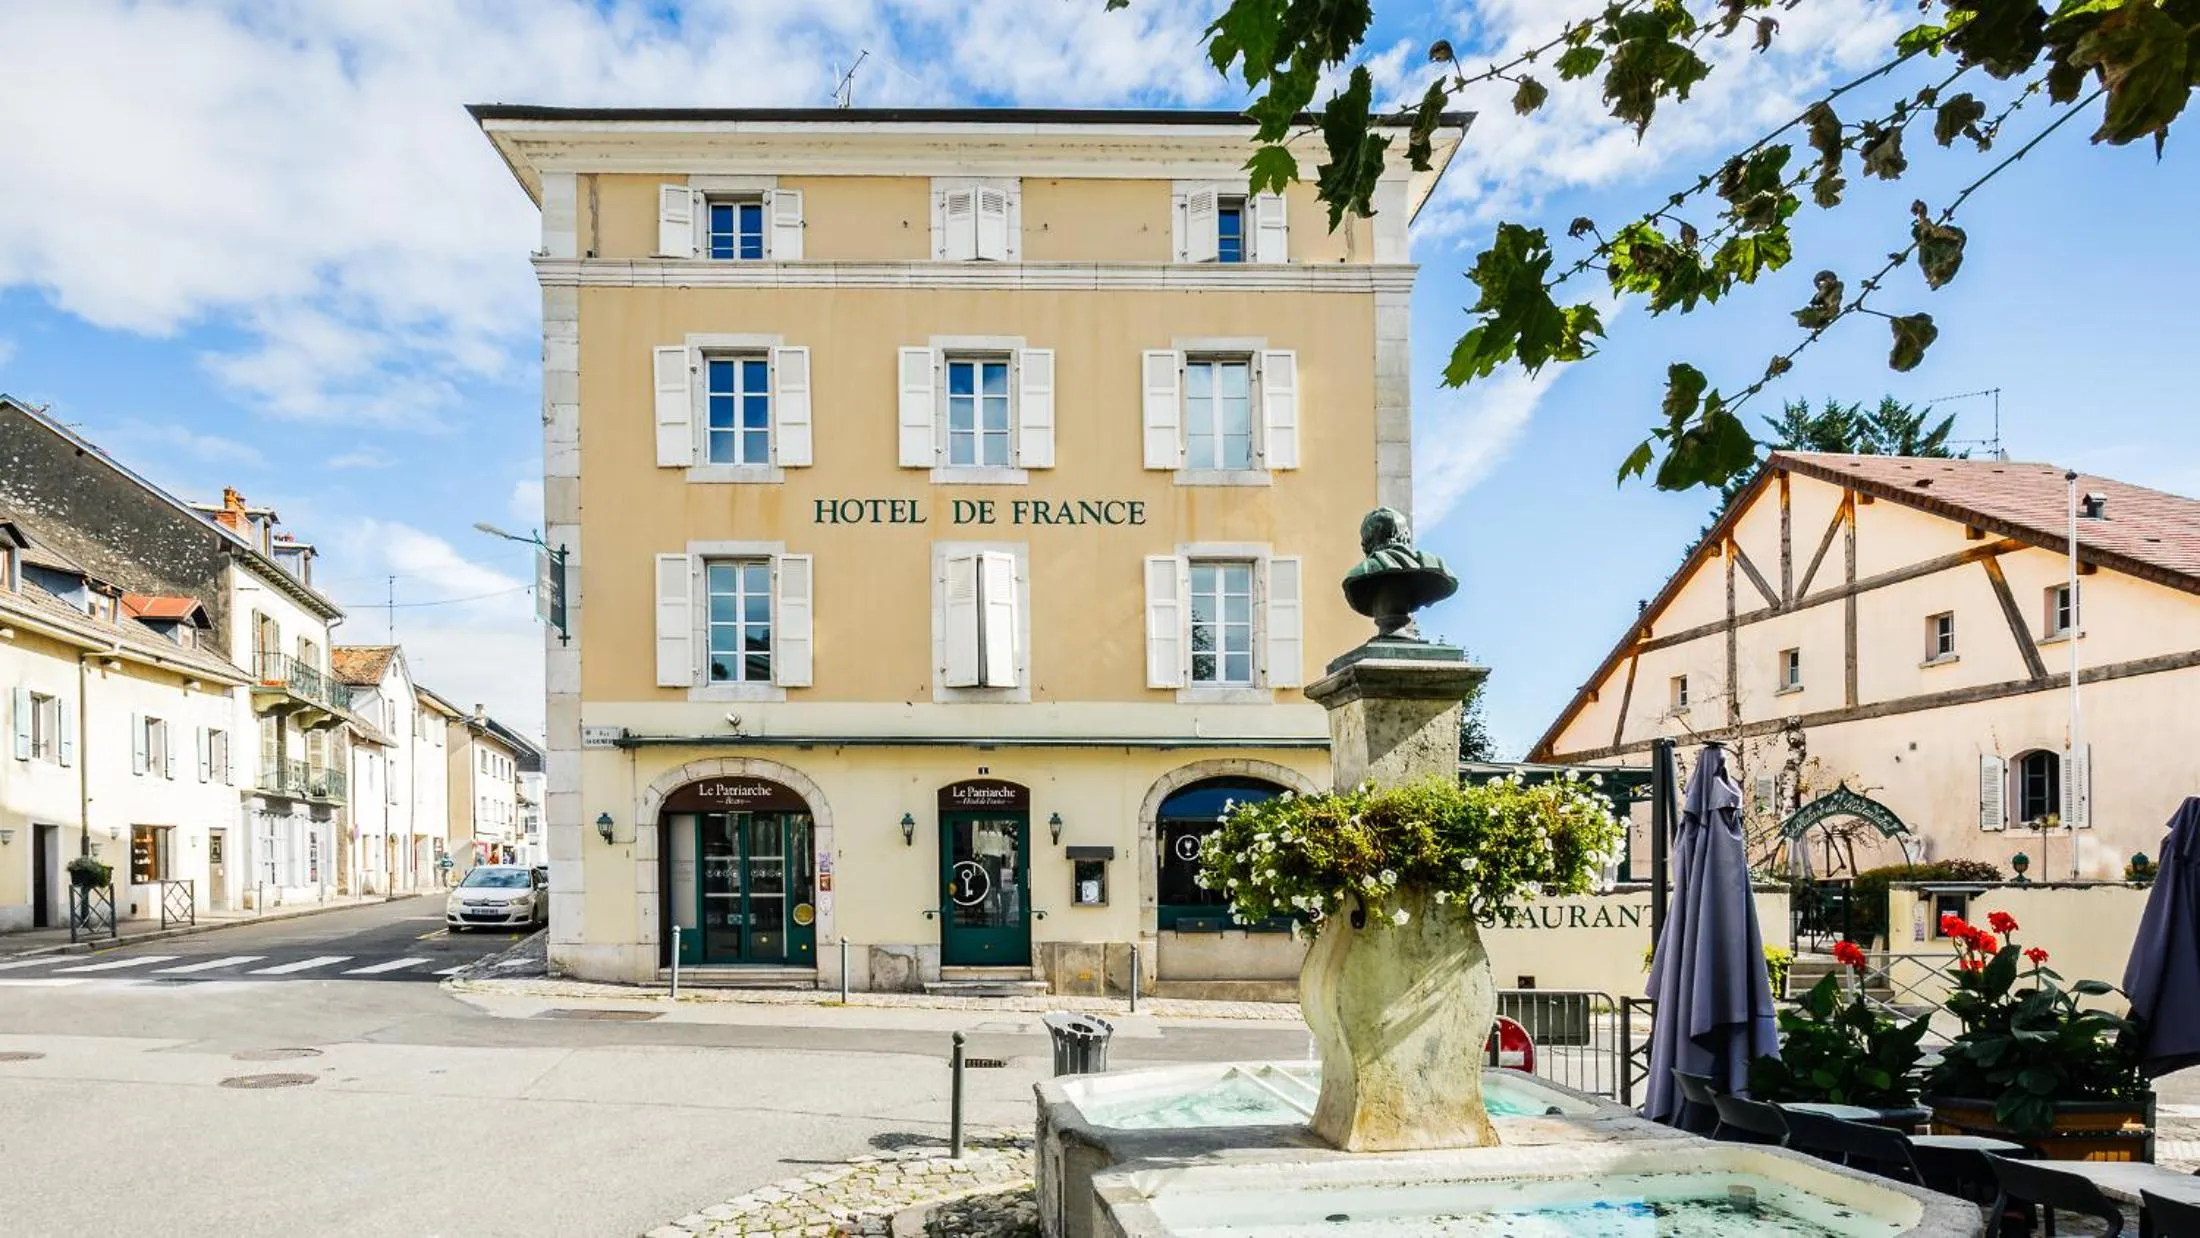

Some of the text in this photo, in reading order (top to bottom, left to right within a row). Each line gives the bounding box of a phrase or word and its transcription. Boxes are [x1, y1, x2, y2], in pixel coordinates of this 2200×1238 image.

[814, 499, 1146, 525] HOTEL DE FRANCE
[699, 782, 773, 796] Le Patriarche
[952, 785, 1016, 797] Le Patriarche
